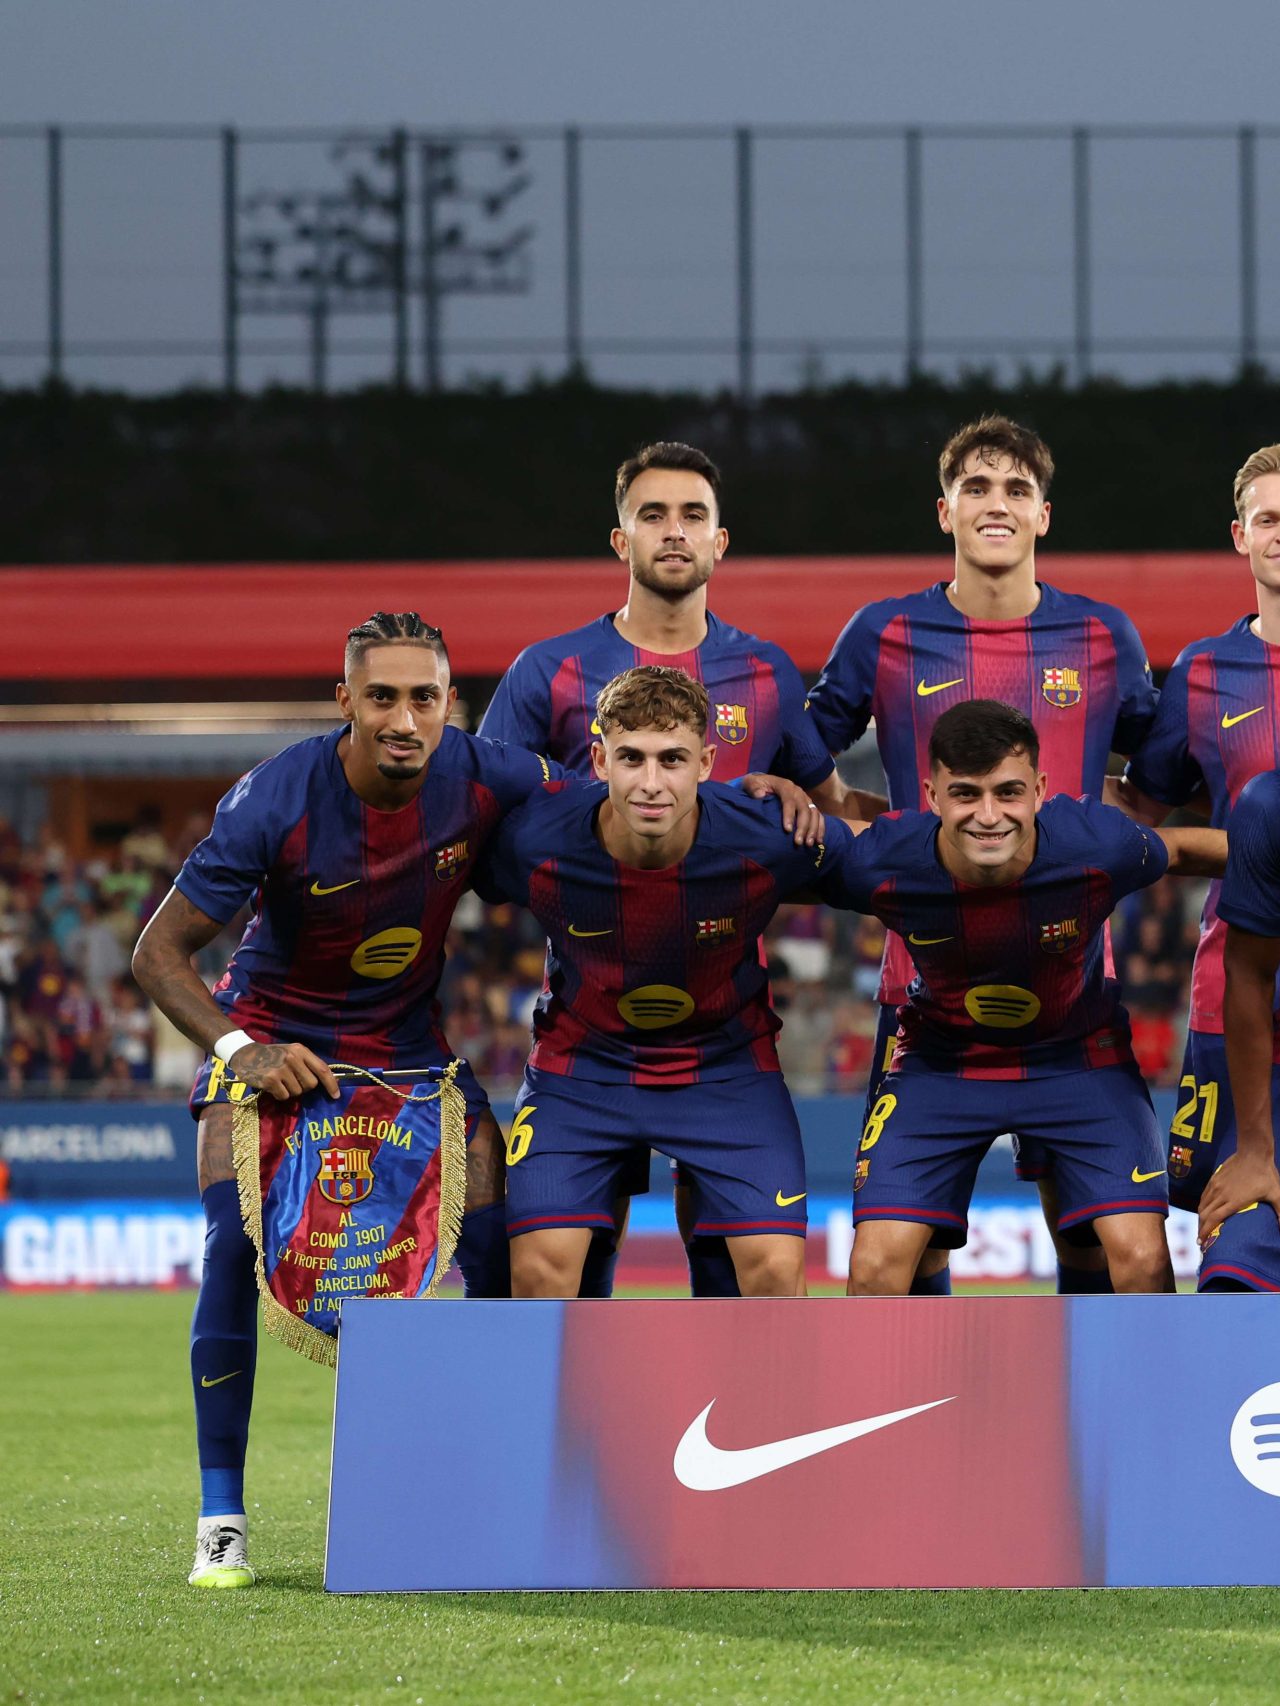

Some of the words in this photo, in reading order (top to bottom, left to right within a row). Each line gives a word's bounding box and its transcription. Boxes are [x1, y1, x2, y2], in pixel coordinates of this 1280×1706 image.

[860, 1093, 898, 1152] 8
[1170, 1074, 1218, 1143] 21
[284, 1130, 302, 1156] FC
[308, 1115, 413, 1151] BARCELONA
[505, 1105, 538, 1167] 6
[333, 1171, 358, 1179] FCB
[339, 1212, 358, 1228] AL
[310, 1231, 348, 1249] COMO
[355, 1225, 385, 1246] 1907
[294, 1251, 337, 1271] TROFEIG
[341, 1254, 371, 1271] JOAN
[374, 1237, 418, 1264] GAMPER
[315, 1273, 390, 1292] BARCELONA
[295, 1299, 309, 1313] 10
